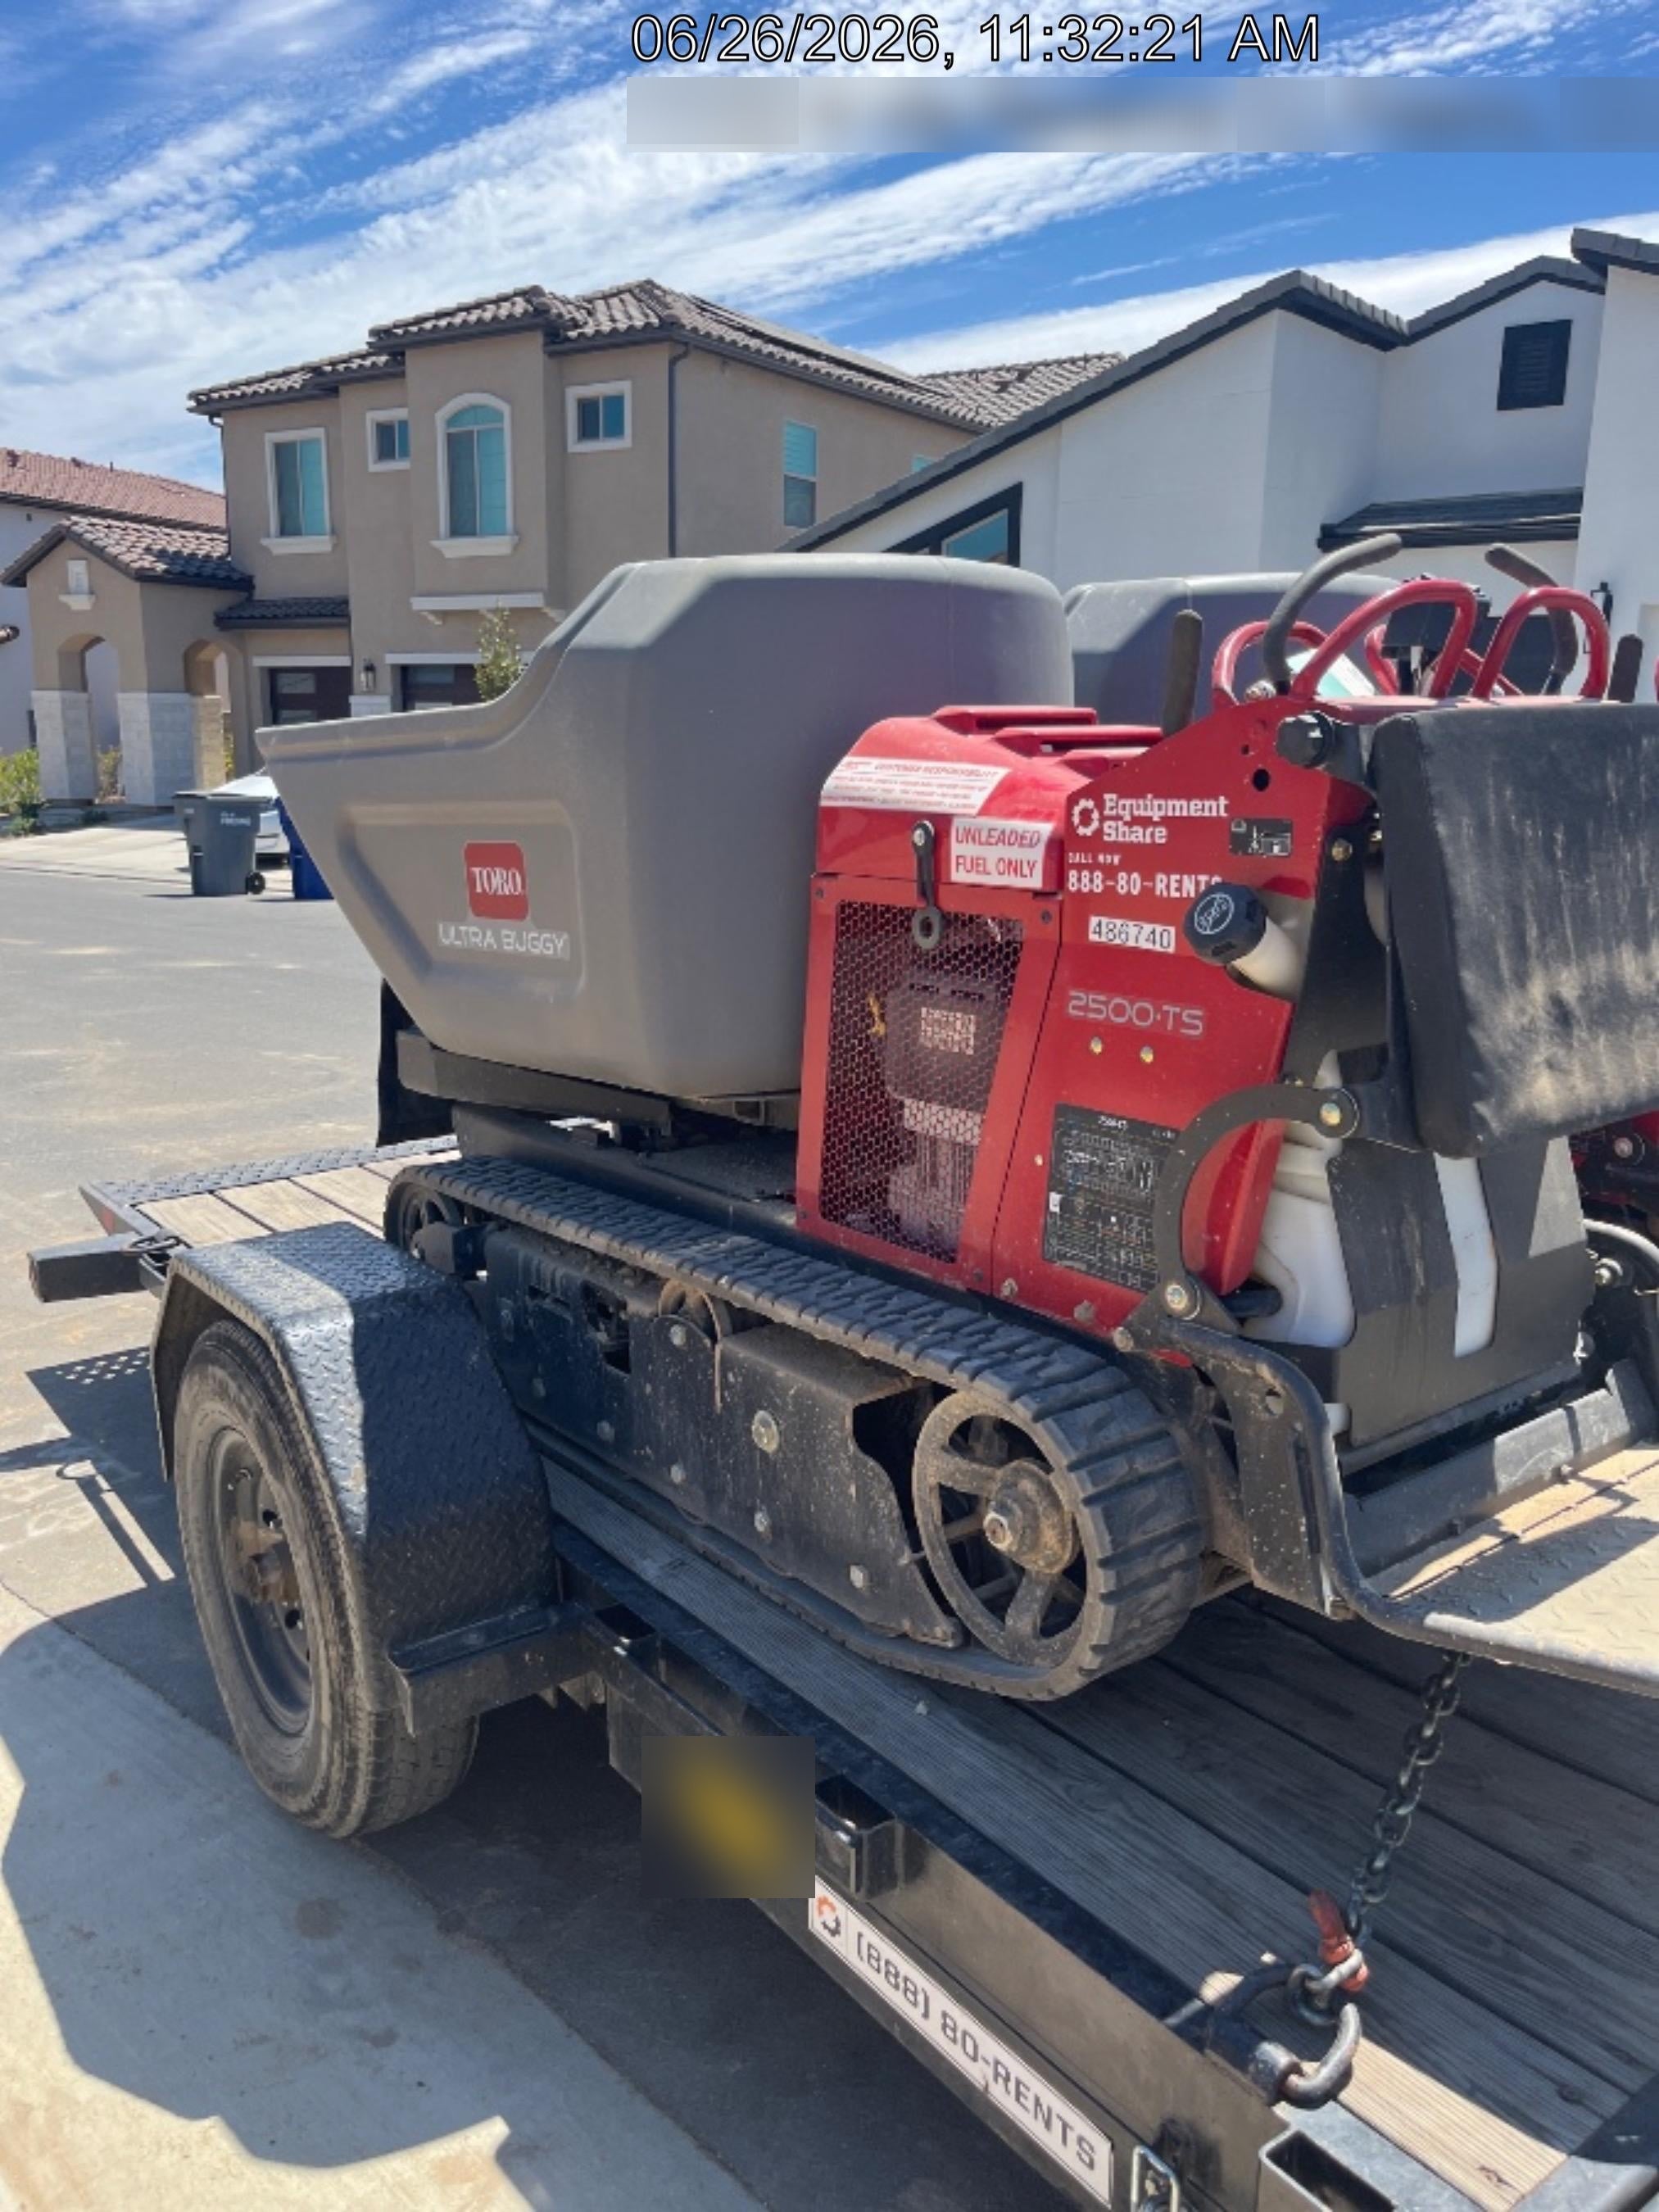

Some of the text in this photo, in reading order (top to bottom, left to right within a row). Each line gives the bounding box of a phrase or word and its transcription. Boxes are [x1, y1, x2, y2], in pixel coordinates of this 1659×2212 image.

[1103, 793, 1229, 821] Equipment
[955, 826, 1040, 849] UNLEADED
[1103, 821, 1168, 844] Share
[955, 854, 1038, 879] FUEL ONLY
[470, 867, 525, 895] TORO
[438, 923, 567, 956] ULTRA BUGGY
[1090, 918, 1172, 950] 486740
[856, 1931, 1096, 2172] (888) 80-RENTS
